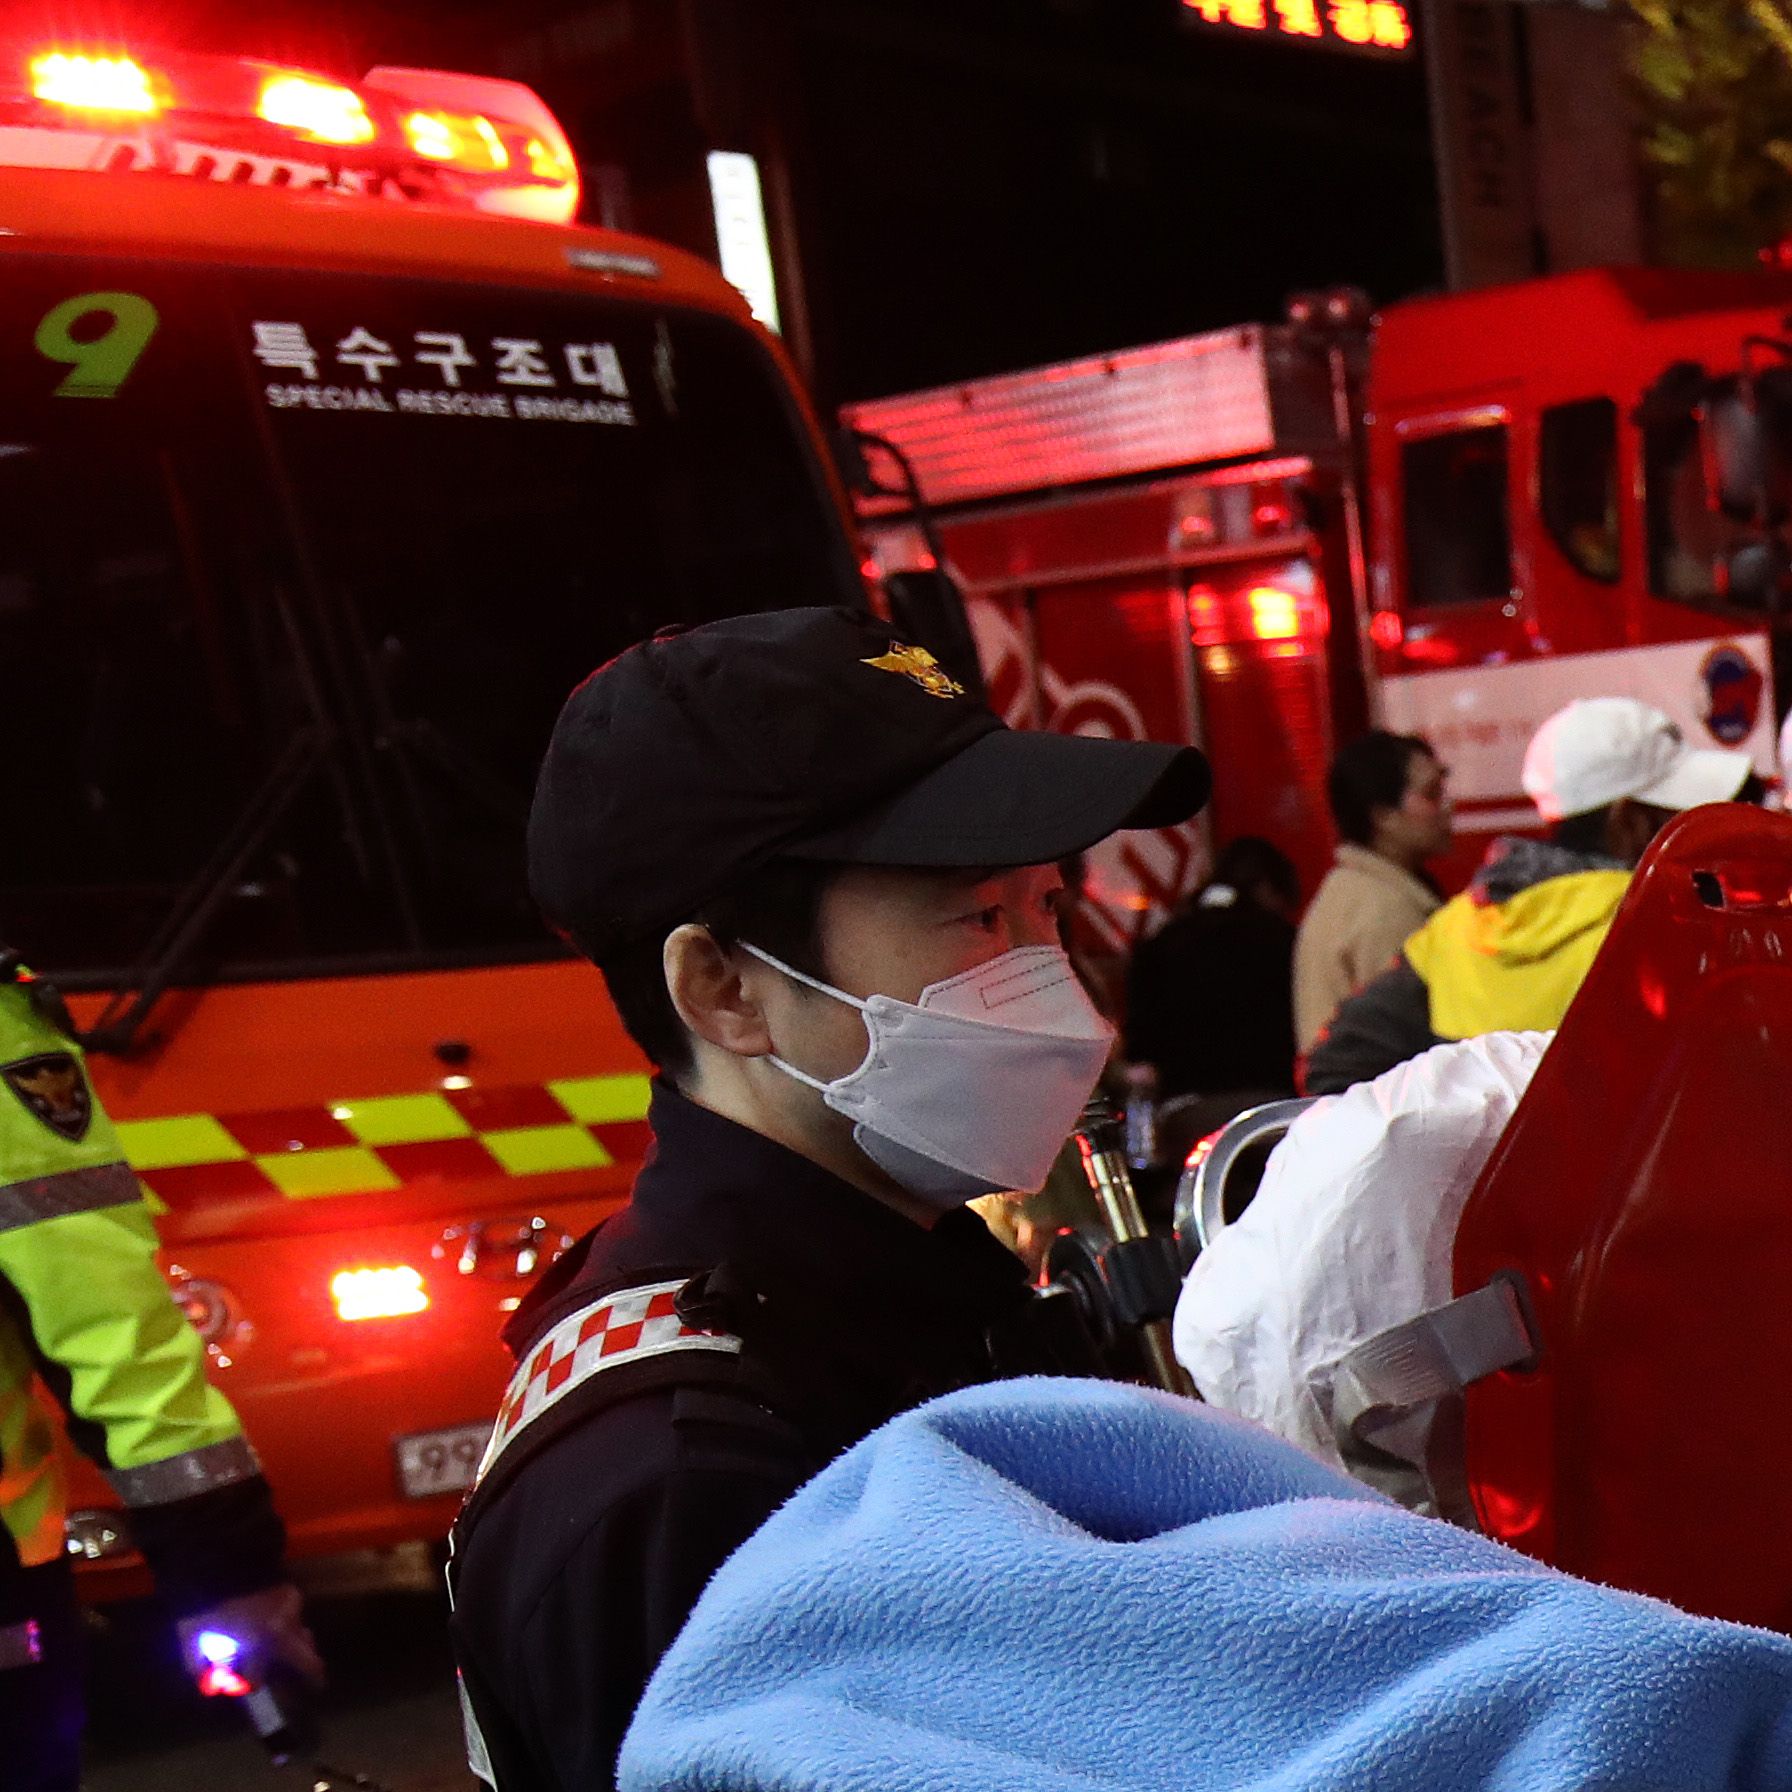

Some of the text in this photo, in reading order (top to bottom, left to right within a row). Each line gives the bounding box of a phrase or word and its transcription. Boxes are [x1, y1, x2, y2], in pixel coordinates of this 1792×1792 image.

[251, 319, 631, 399] 특수구조대
[265, 383, 639, 426] SPECIAL RESCUE BRIGADE
